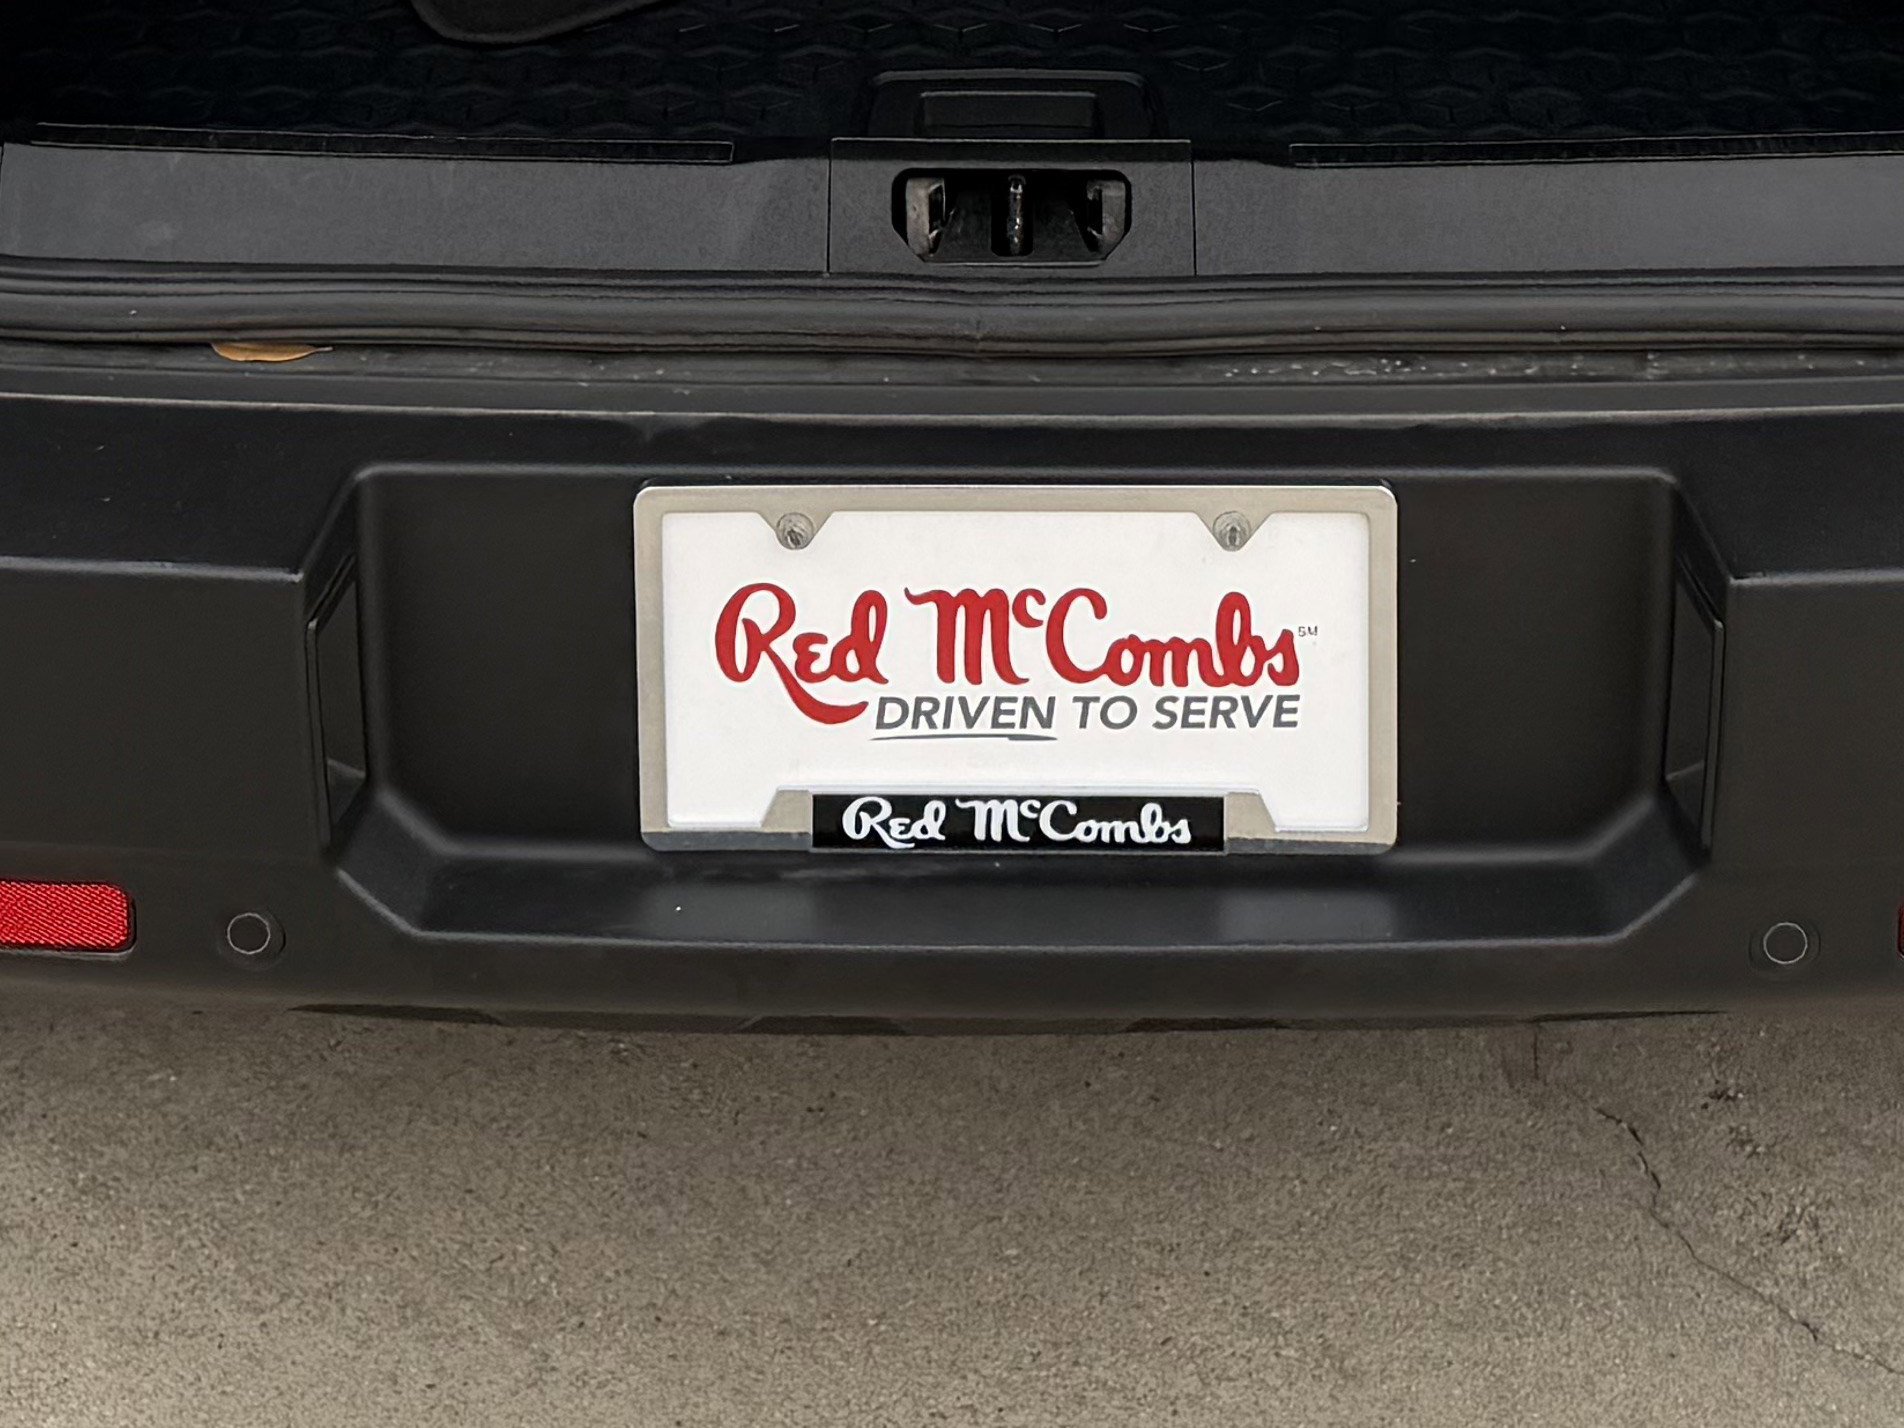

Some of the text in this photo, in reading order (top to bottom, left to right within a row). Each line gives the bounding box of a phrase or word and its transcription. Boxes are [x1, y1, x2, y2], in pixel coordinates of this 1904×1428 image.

[714, 582, 889, 724] Red
[903, 587, 1300, 687] McCombs
[876, 694, 1301, 730] DRIVEN TO SERVE
[842, 796, 1192, 849] Red McCombs
